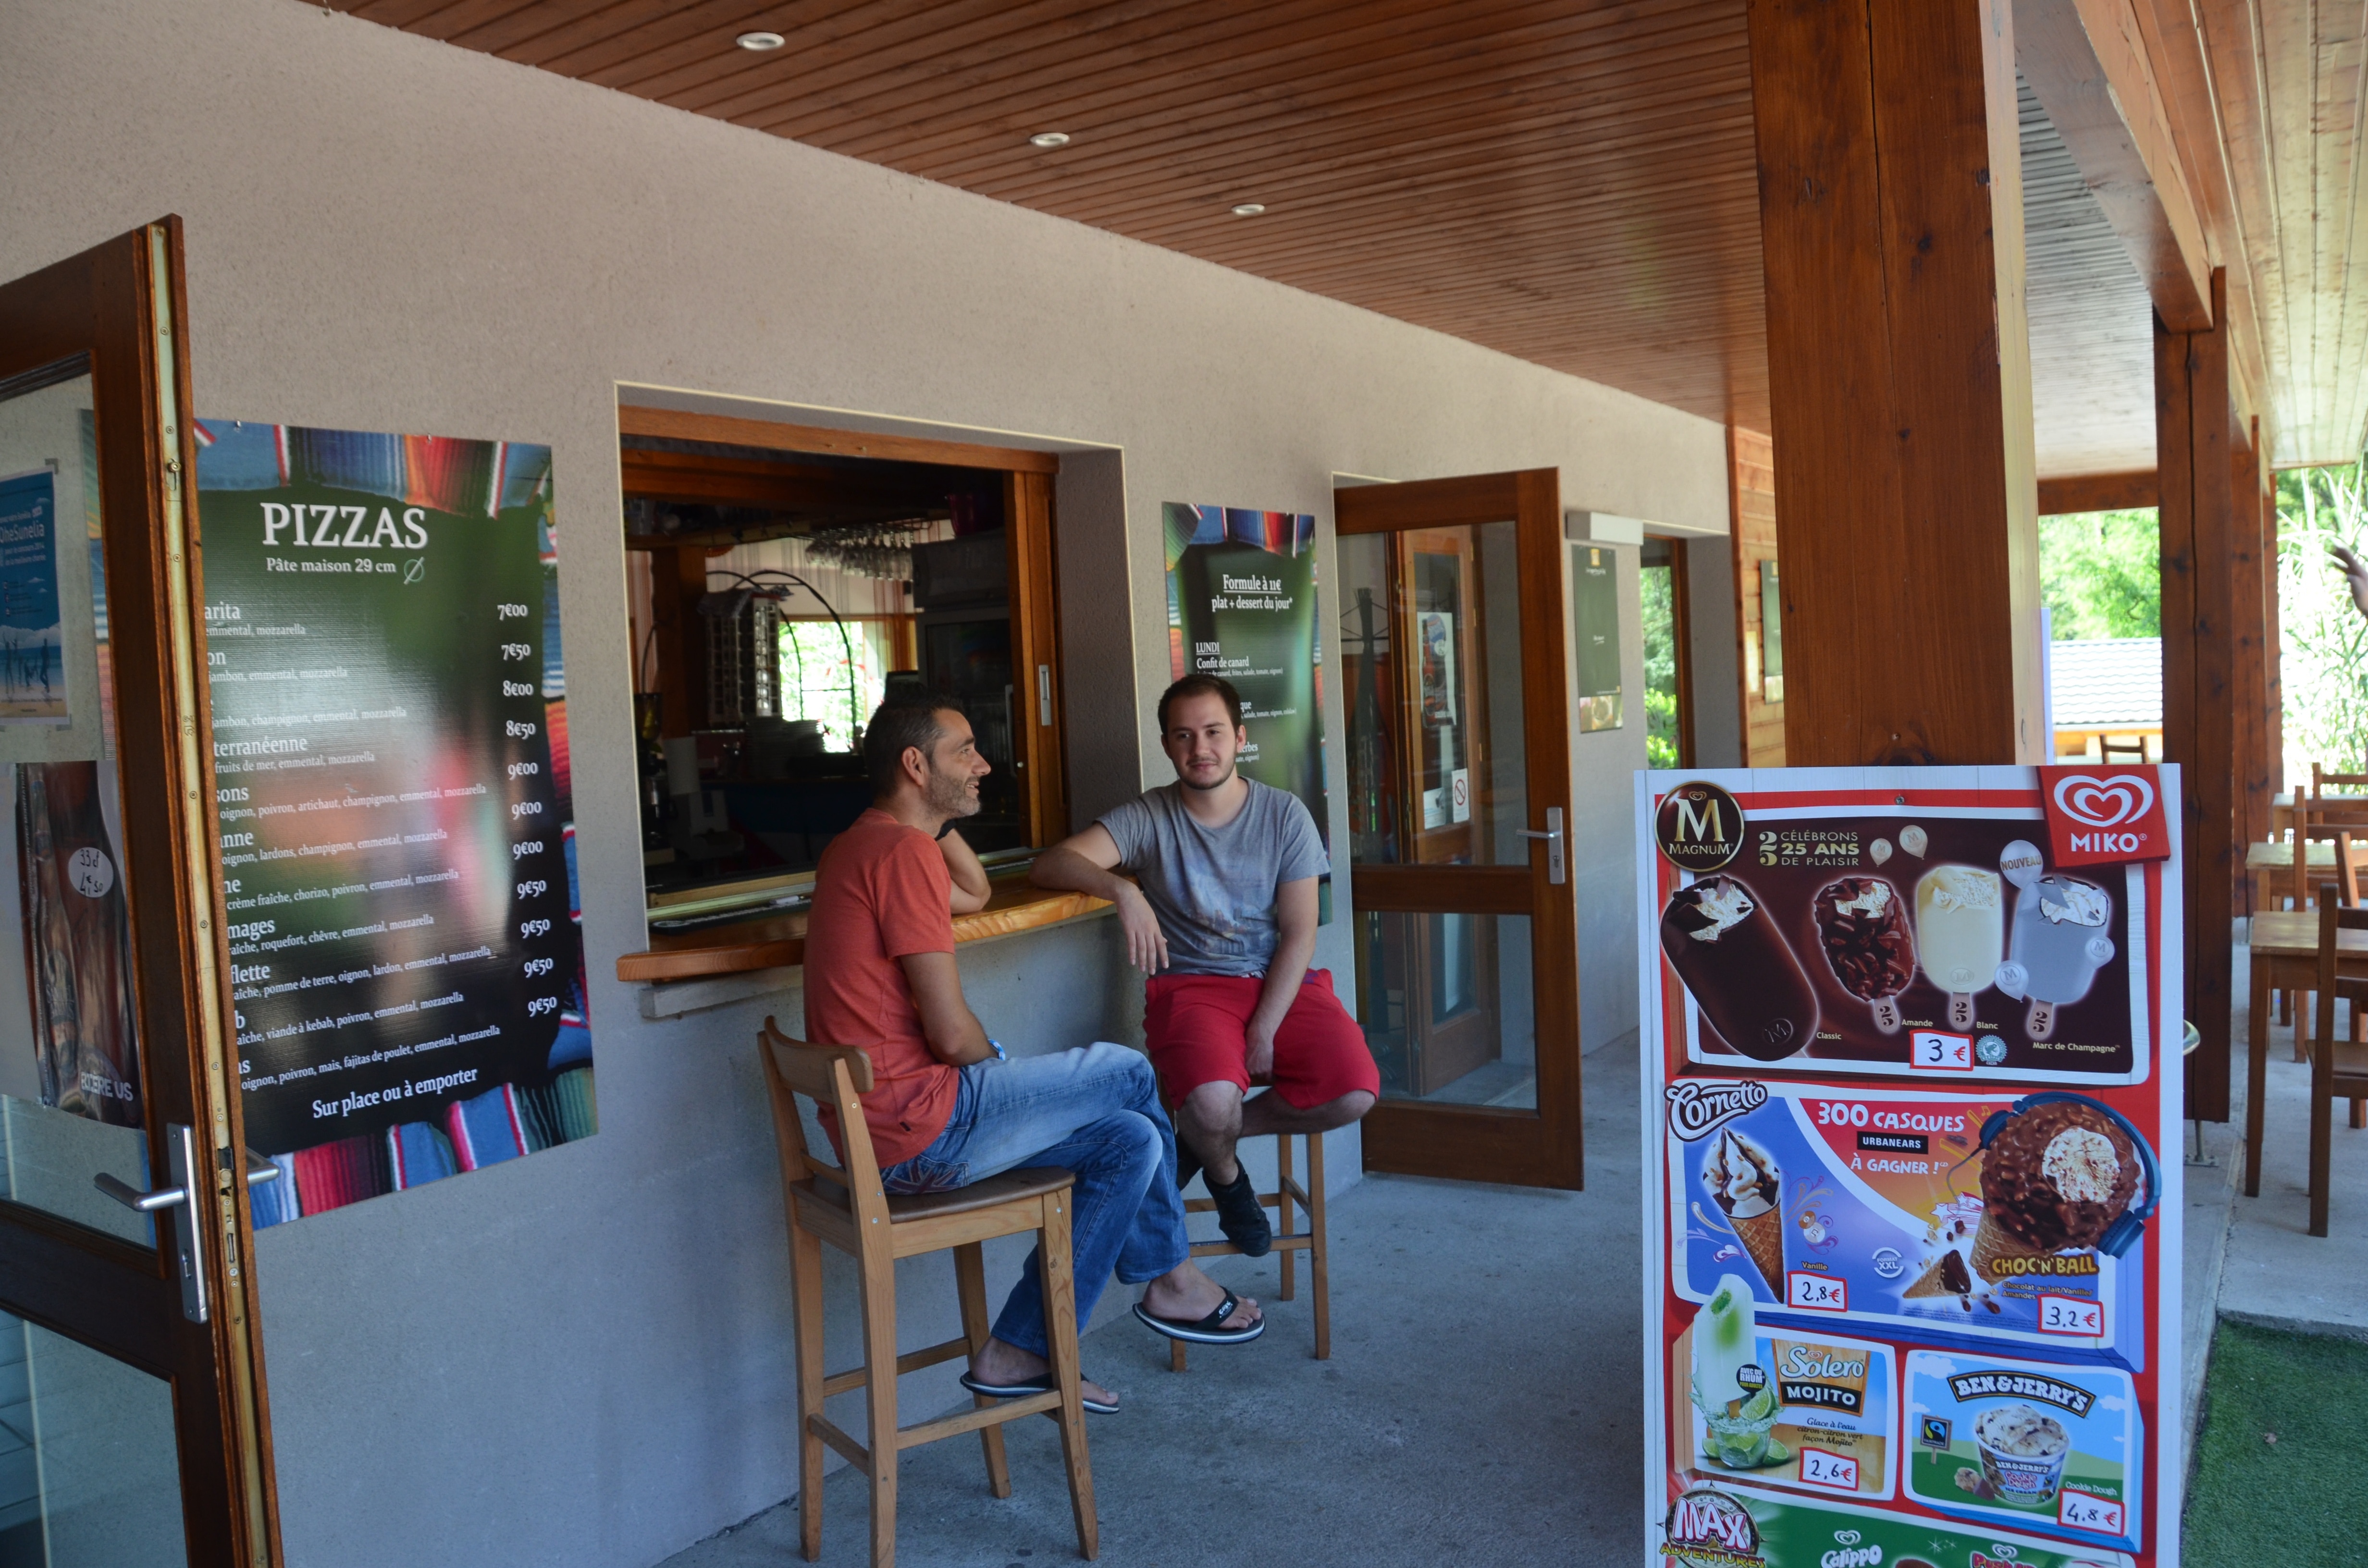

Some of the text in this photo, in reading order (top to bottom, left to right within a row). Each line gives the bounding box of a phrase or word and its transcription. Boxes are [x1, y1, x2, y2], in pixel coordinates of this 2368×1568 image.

[260, 502, 428, 549] PIZZAS
[266, 557, 396, 573] Pâte maison 29 cm
[1222, 574, 1261, 591] Formule
[1262, 576, 1268, 591] à
[1211, 595, 1228, 612] plat
[1236, 595, 1263, 609] dessert
[1264, 596, 1274, 609] du
[497, 604, 528, 621] 7€00
[256, 624, 306, 635] mozzarella
[501, 644, 531, 661] 7€50
[1196, 642, 1220, 654] LUNDI
[1196, 656, 1249, 669] Confit de canard
[503, 680, 533, 697] 8€00
[361, 707, 407, 718] mozzarella
[506, 720, 536, 740] 8€50
[215, 751, 375, 773] fruits de mer, emmental, mozzarella
[508, 762, 538, 780] 9€00
[220, 783, 486, 821] oignon, poivron, artichaut, champignon, emmental, mozzarella
[511, 801, 542, 820] 9€00
[1675, 799, 1725, 842] M
[1780, 830, 1858, 841] CÉLÉBRONS
[2071, 833, 2139, 853] MIKO
[222, 829, 447, 867] oignon, lardons, champignon, emmental, mozzarella
[513, 841, 543, 860] 9€00
[1669, 843, 1730, 855] MAGNUM
[1781, 843, 1860, 855] 25 ANS
[1807, 858, 1859, 866] PLAISIR
[2000, 855, 2042, 871] NOUVEAU
[227, 869, 459, 910] crème fraîche, chorizo, poivron, emmental, mozzarella
[517, 880, 547, 899] 9€50
[261, 935, 307, 952] roquefort,
[342, 921, 387, 937] emmental,
[389, 914, 434, 931] mozzarella
[521, 919, 551, 939] 9€50
[264, 982, 298, 998] pomme
[300, 977, 311, 989] de
[313, 974, 337, 986] terre,
[338, 970, 371, 983] oignon,
[373, 963, 403, 976] lardon,
[405, 953, 448, 970] emmental,
[449, 945, 491, 962] mozzarella
[524, 958, 554, 978] 9€50
[266, 1024, 297, 1039] viande
[298, 1022, 304, 1033] à
[306, 1017, 335, 1032] kebab,
[337, 1011, 373, 1029] poivron,
[374, 1000, 419, 1018] emmental,
[420, 992, 464, 1009] mozzarella
[528, 997, 557, 1017] 9€50
[1901, 1019, 1934, 1027] Amande
[1976, 1021, 1998, 1029] Blanc
[1816, 1032, 1841, 1040] Classic
[2068, 1043, 2116, 1054] Champagne
[242, 1076, 278, 1090] oignon,
[279, 1066, 317, 1085] poivron,
[344, 1054, 371, 1069] fajitas
[371, 1050, 383, 1062] de
[383, 1045, 414, 1062] poulet,
[415, 1034, 457, 1052] emmental,
[458, 1025, 500, 1042] mozzarella
[312, 1068, 478, 1118] Sur place ou à emporter
[1665, 1082, 1766, 1140] Cornetto
[1818, 1102, 1965, 1132] 300 CASQUES
[1862, 1137, 1921, 1149] URBANEARS
[1850, 1152, 1929, 1175] À GAGNER
[1802, 1262, 1828, 1271] Vanille
[1878, 1262, 1899, 1270] XXL
[2002, 1281, 2035, 1291] Chocolat
[2003, 1290, 2035, 1300] Amandes
[1780, 1346, 1864, 1378] Solero
[1740, 1373, 1763, 1383] RHUM
[1786, 1386, 1855, 1406] MOJITO
[1797, 1426, 1846, 1437] citron-citron
[1807, 1417, 1828, 1427] Glace
[1838, 1421, 1856, 1430] l'eau
[1802, 1434, 1824, 1443] façon
[2065, 1481, 2092, 1492] Cookie
[1673, 1498, 1749, 1551] MAX
[1659, 1542, 1765, 1568] ADVENTURES
